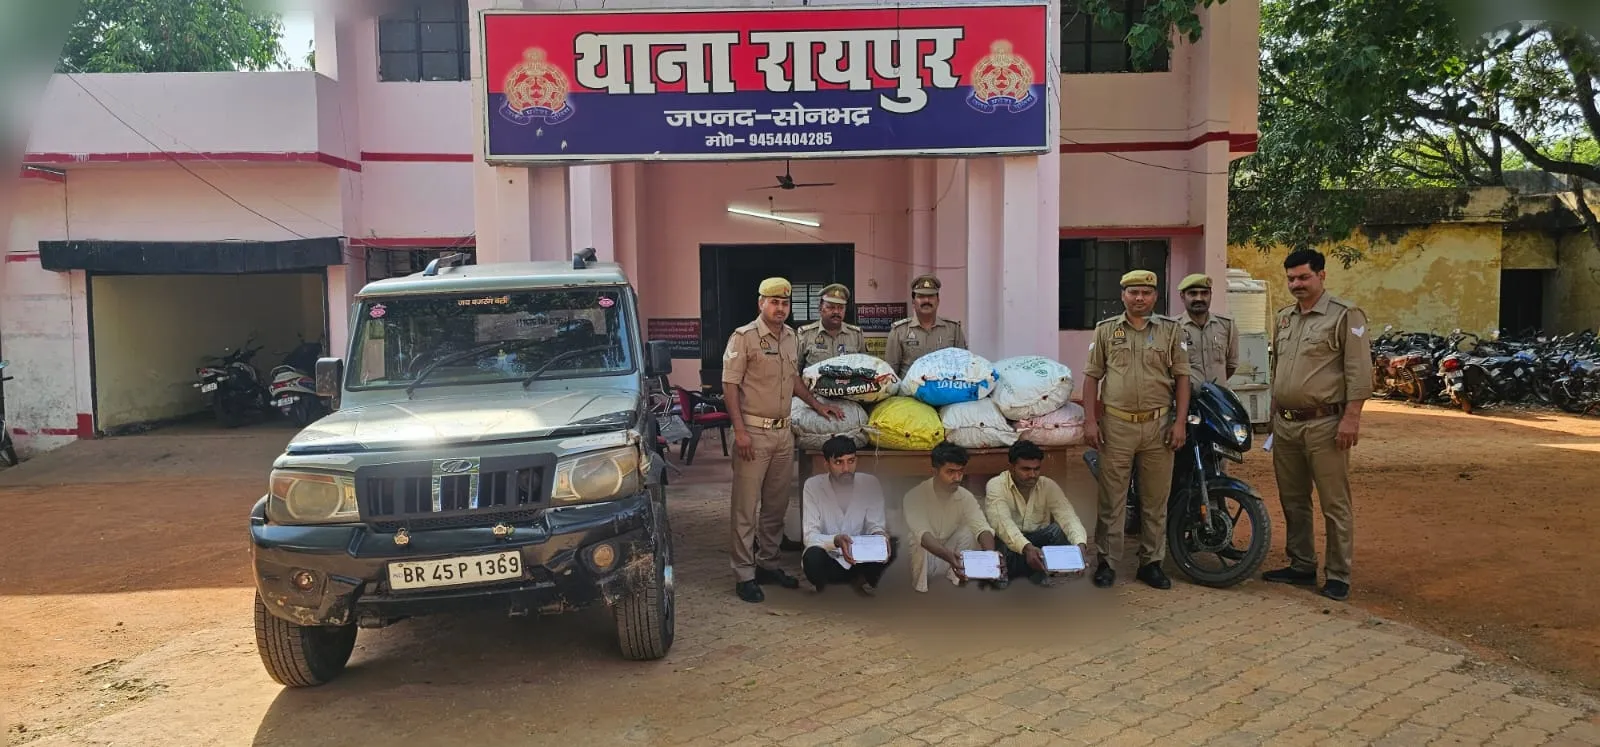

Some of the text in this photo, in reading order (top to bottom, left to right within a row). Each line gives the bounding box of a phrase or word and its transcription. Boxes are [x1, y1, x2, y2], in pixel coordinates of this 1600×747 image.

[574, 26, 965, 114] थाना रायपुर
[664, 102, 873, 127] जपनद-सोनभद्र
[749, 132, 833, 146] 9454404285
[846, 381, 878, 395] SPECIAL
[403, 566, 426, 583] BR
[432, 564, 454, 581] 45
[458, 562, 468, 578] P
[475, 554, 519, 576] 1369
